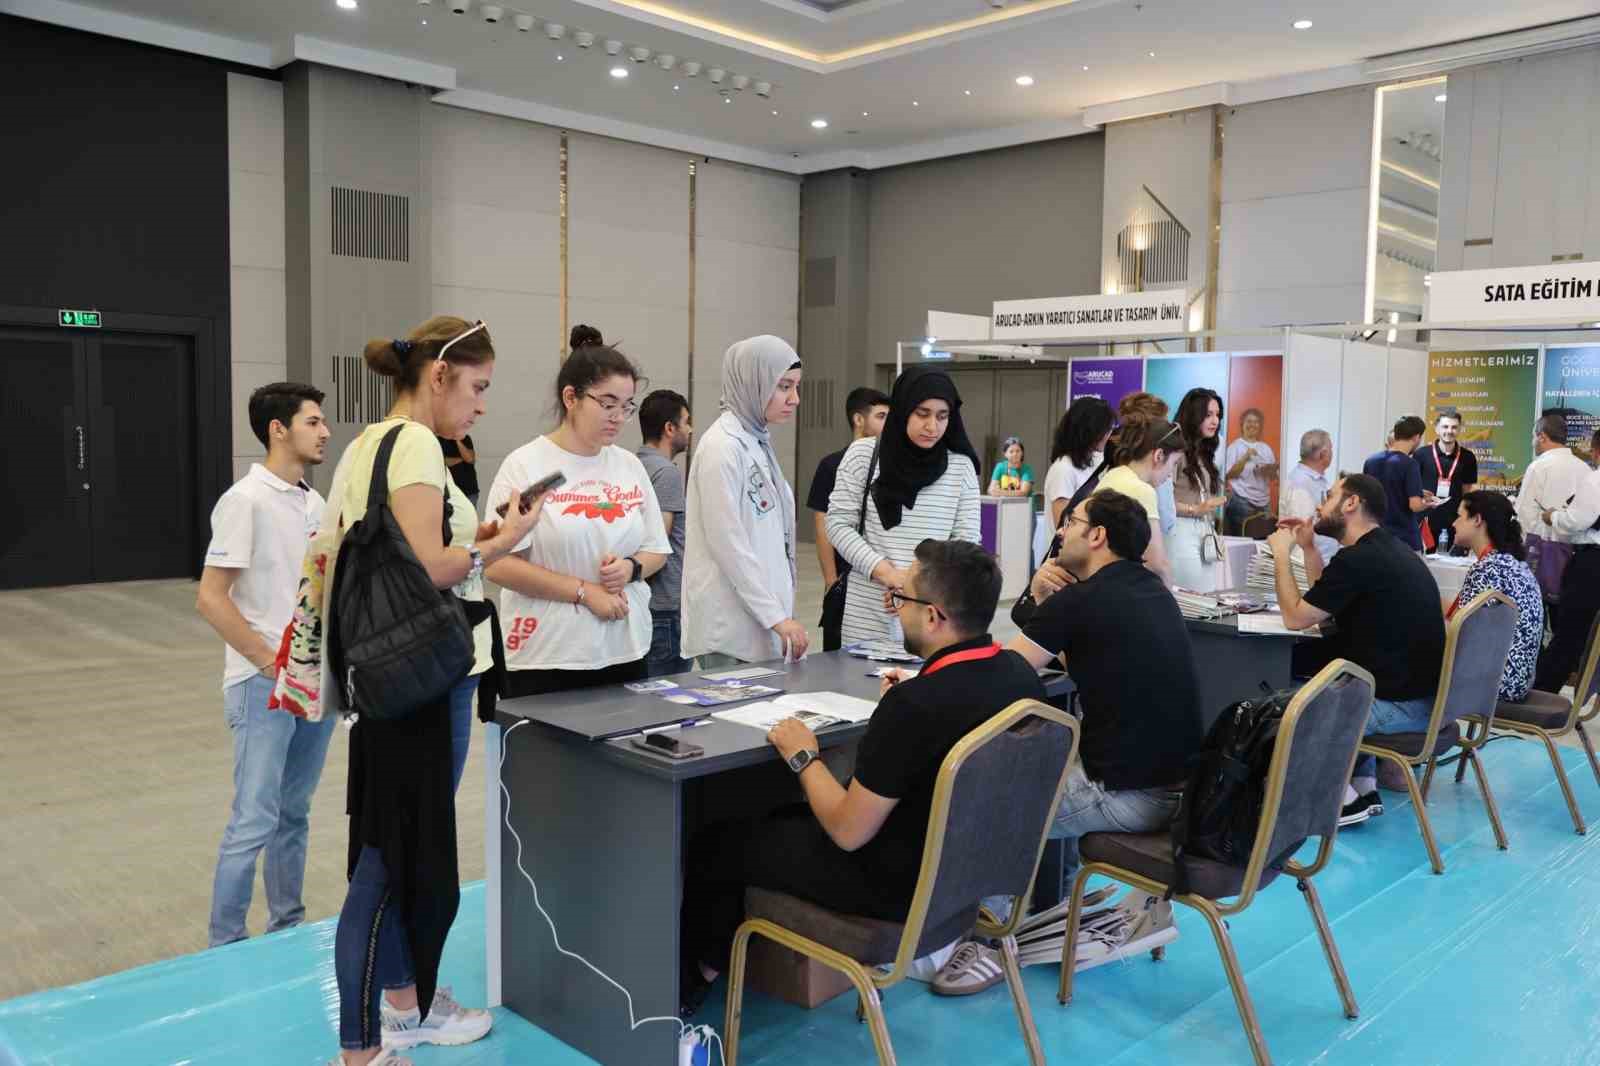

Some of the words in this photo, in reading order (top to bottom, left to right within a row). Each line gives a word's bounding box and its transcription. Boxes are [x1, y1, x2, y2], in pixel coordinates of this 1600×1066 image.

[1484, 284, 1525, 302] SATA
[1530, 277, 1592, 300] EĞİTİM
[995, 312, 1044, 327] ARUCAD-ARKIN
[1045, 310, 1076, 325] YARATICI
[1077, 308, 1113, 324] SANATLAR
[1114, 308, 1124, 322] VE
[1125, 306, 1158, 321] TASARIM
[1160, 303, 1182, 320] ÜNİV.
[1432, 354, 1535, 368] HİZMETLERİMİZ
[602, 484, 644, 502] Goals
[511, 616, 538, 634] 19
